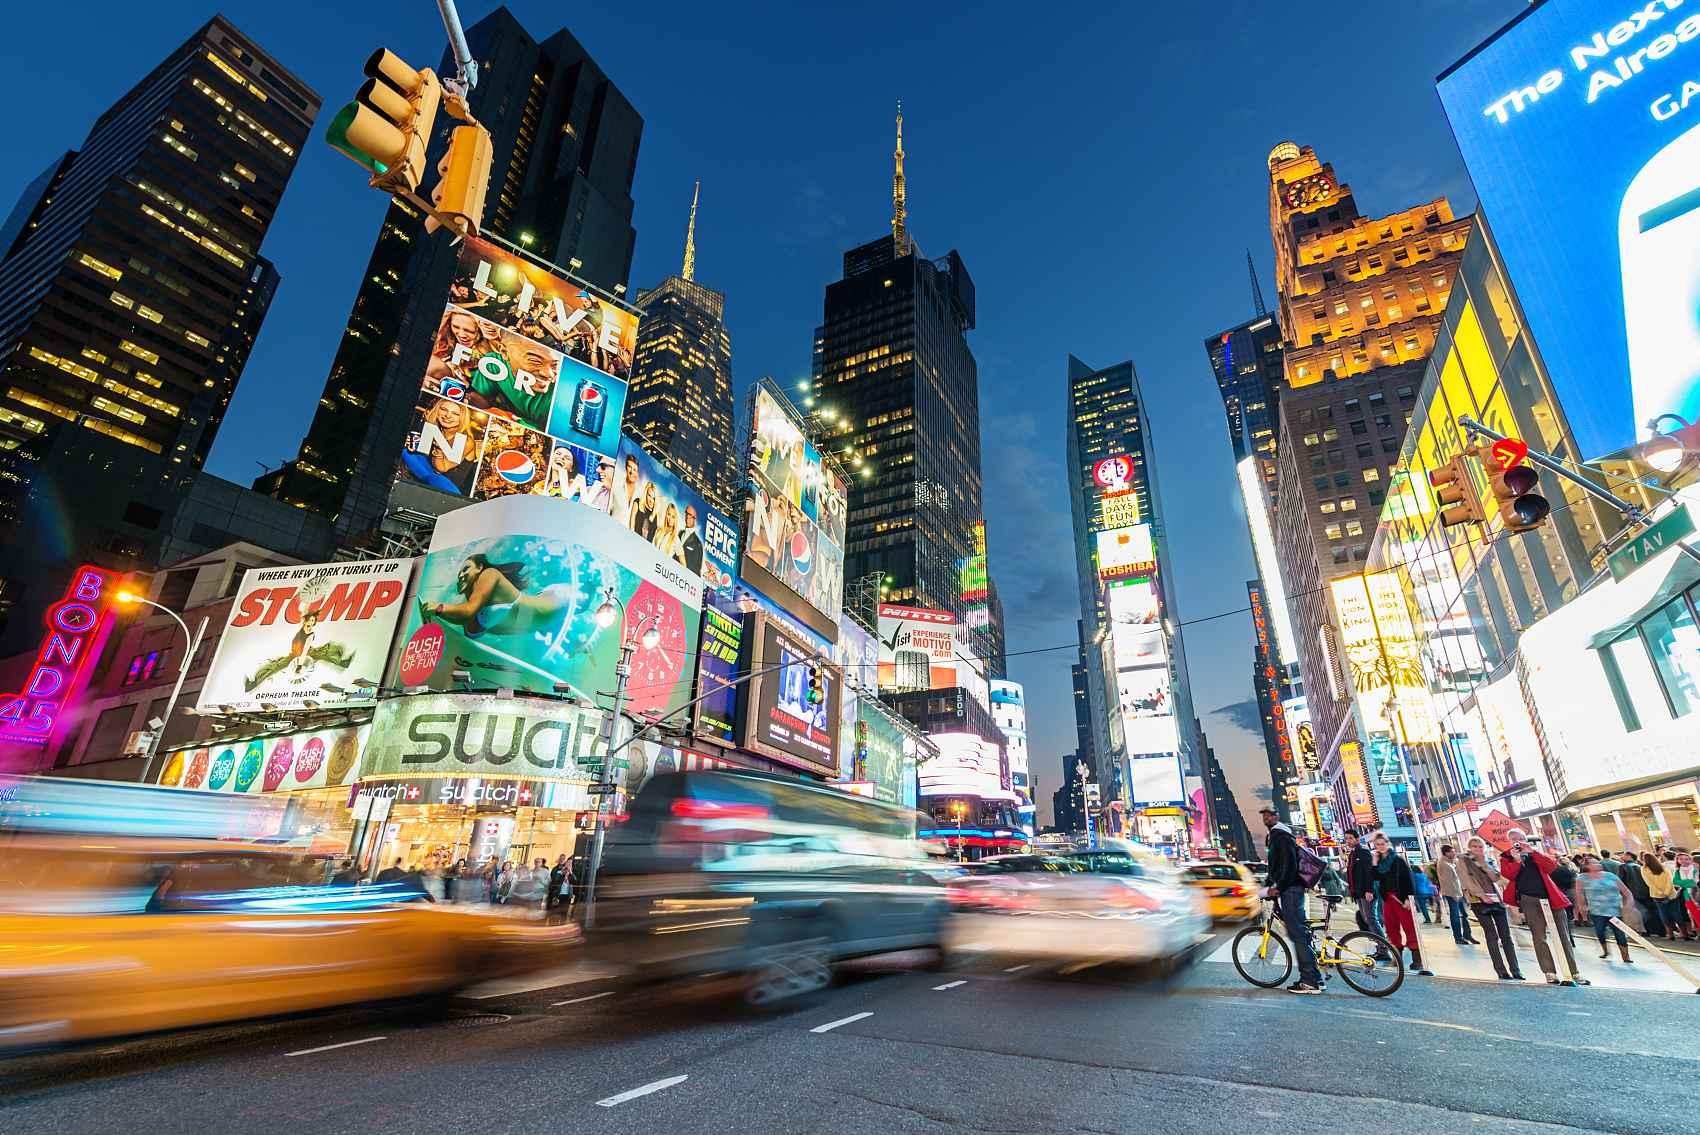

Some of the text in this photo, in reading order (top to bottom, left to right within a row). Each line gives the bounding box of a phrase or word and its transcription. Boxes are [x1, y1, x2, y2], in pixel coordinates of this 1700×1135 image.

[1483, 70, 1563, 124] The
[473, 260, 624, 354] LIVE
[451, 343, 537, 397] FOR
[1105, 503, 1133, 514] DAYS
[1110, 511, 1133, 522] FUN
[705, 520, 737, 559] EPIC
[704, 541, 735, 568] MOMENT
[1628, 545, 1638, 562] 7
[258, 563, 399, 581] WHERE NEW YORK TURNS IT UP
[655, 562, 690, 592] swatch
[1100, 560, 1154, 577] TOSHIBA
[230, 580, 403, 627] STOMP
[882, 608, 953, 620] NITTO
[1250, 591, 1270, 654] ERNST
[1342, 618, 1370, 629] KING
[29, 573, 102, 696] BOND
[912, 629, 952, 639] EXPERIENCE
[406, 635, 442, 654] PUSH
[912, 638, 952, 651] MOTIVO
[406, 650, 439, 661] THE BUTTON
[932, 650, 952, 658] .com
[402, 657, 437, 672] OF FUN
[256, 690, 320, 700] ORPHEUM THEATRE
[0, 700, 52, 731] 45
[1269, 690, 1292, 761] YOUNG
[301, 748, 323, 760] PUSH
[215, 759, 233, 770] PUSH
[439, 784, 519, 801] swatch
